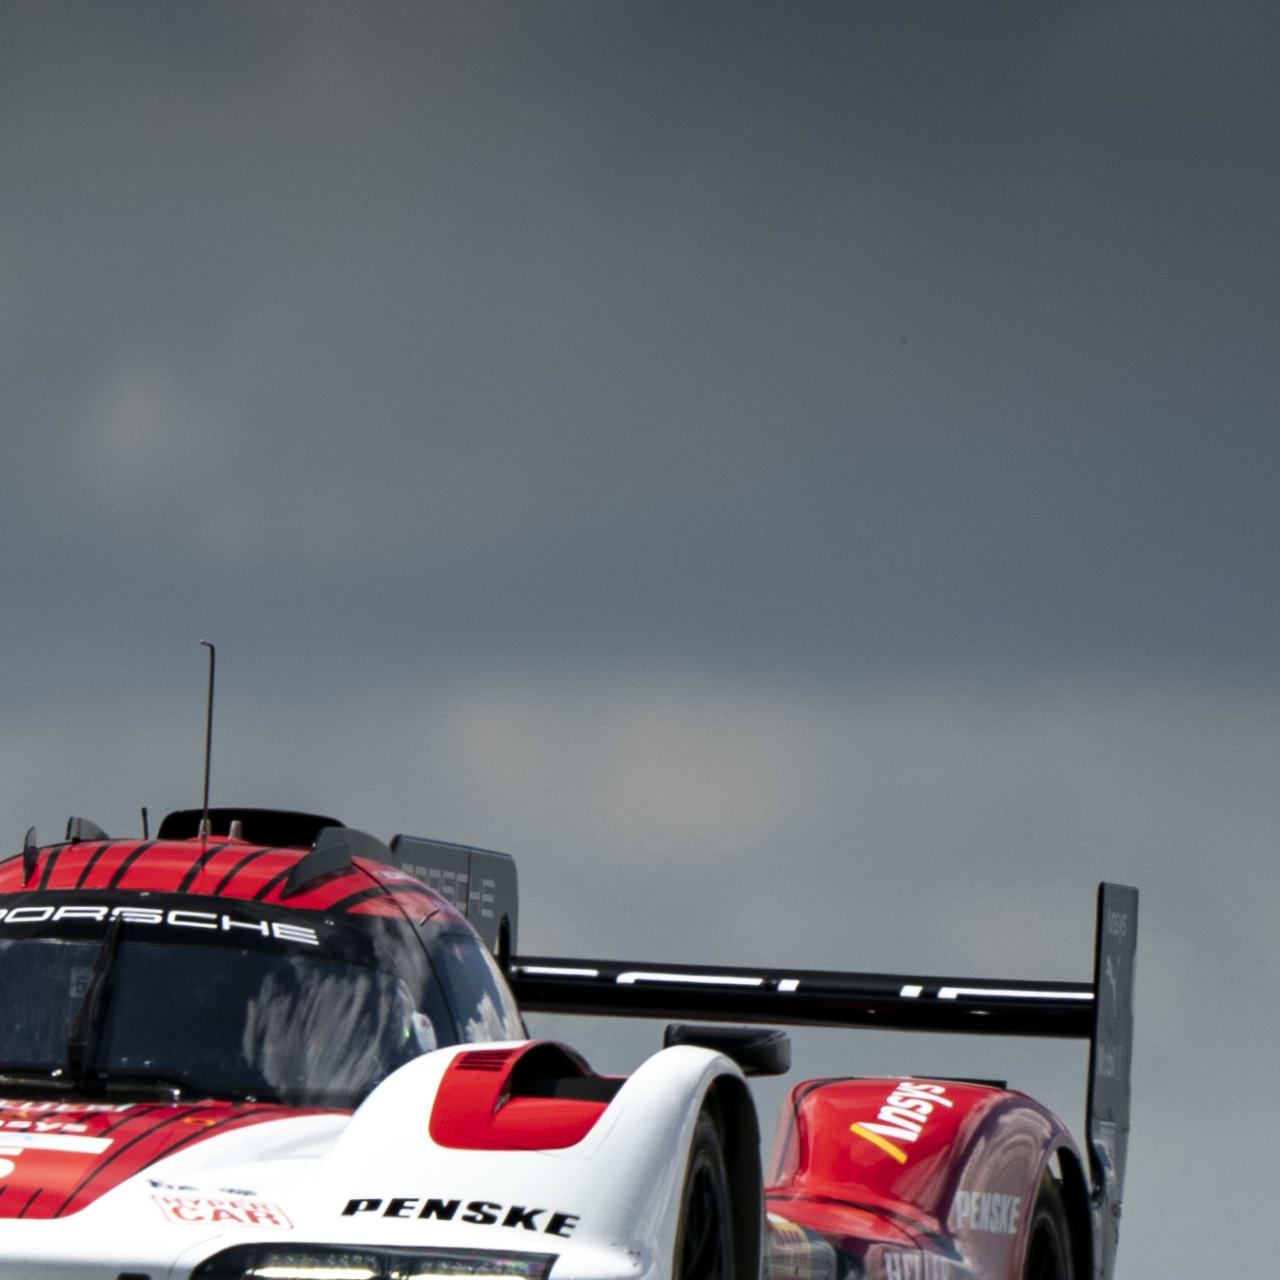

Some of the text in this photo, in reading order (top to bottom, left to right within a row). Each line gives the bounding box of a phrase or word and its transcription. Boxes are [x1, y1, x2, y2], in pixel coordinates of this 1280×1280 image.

[401, 863, 495, 919] RSCHE
[850, 1081, 954, 1165] Ansys
[171, 1206, 282, 1226] CAR
[340, 1197, 581, 1239] PENSKE
[956, 1190, 1021, 1235] PENSKE
